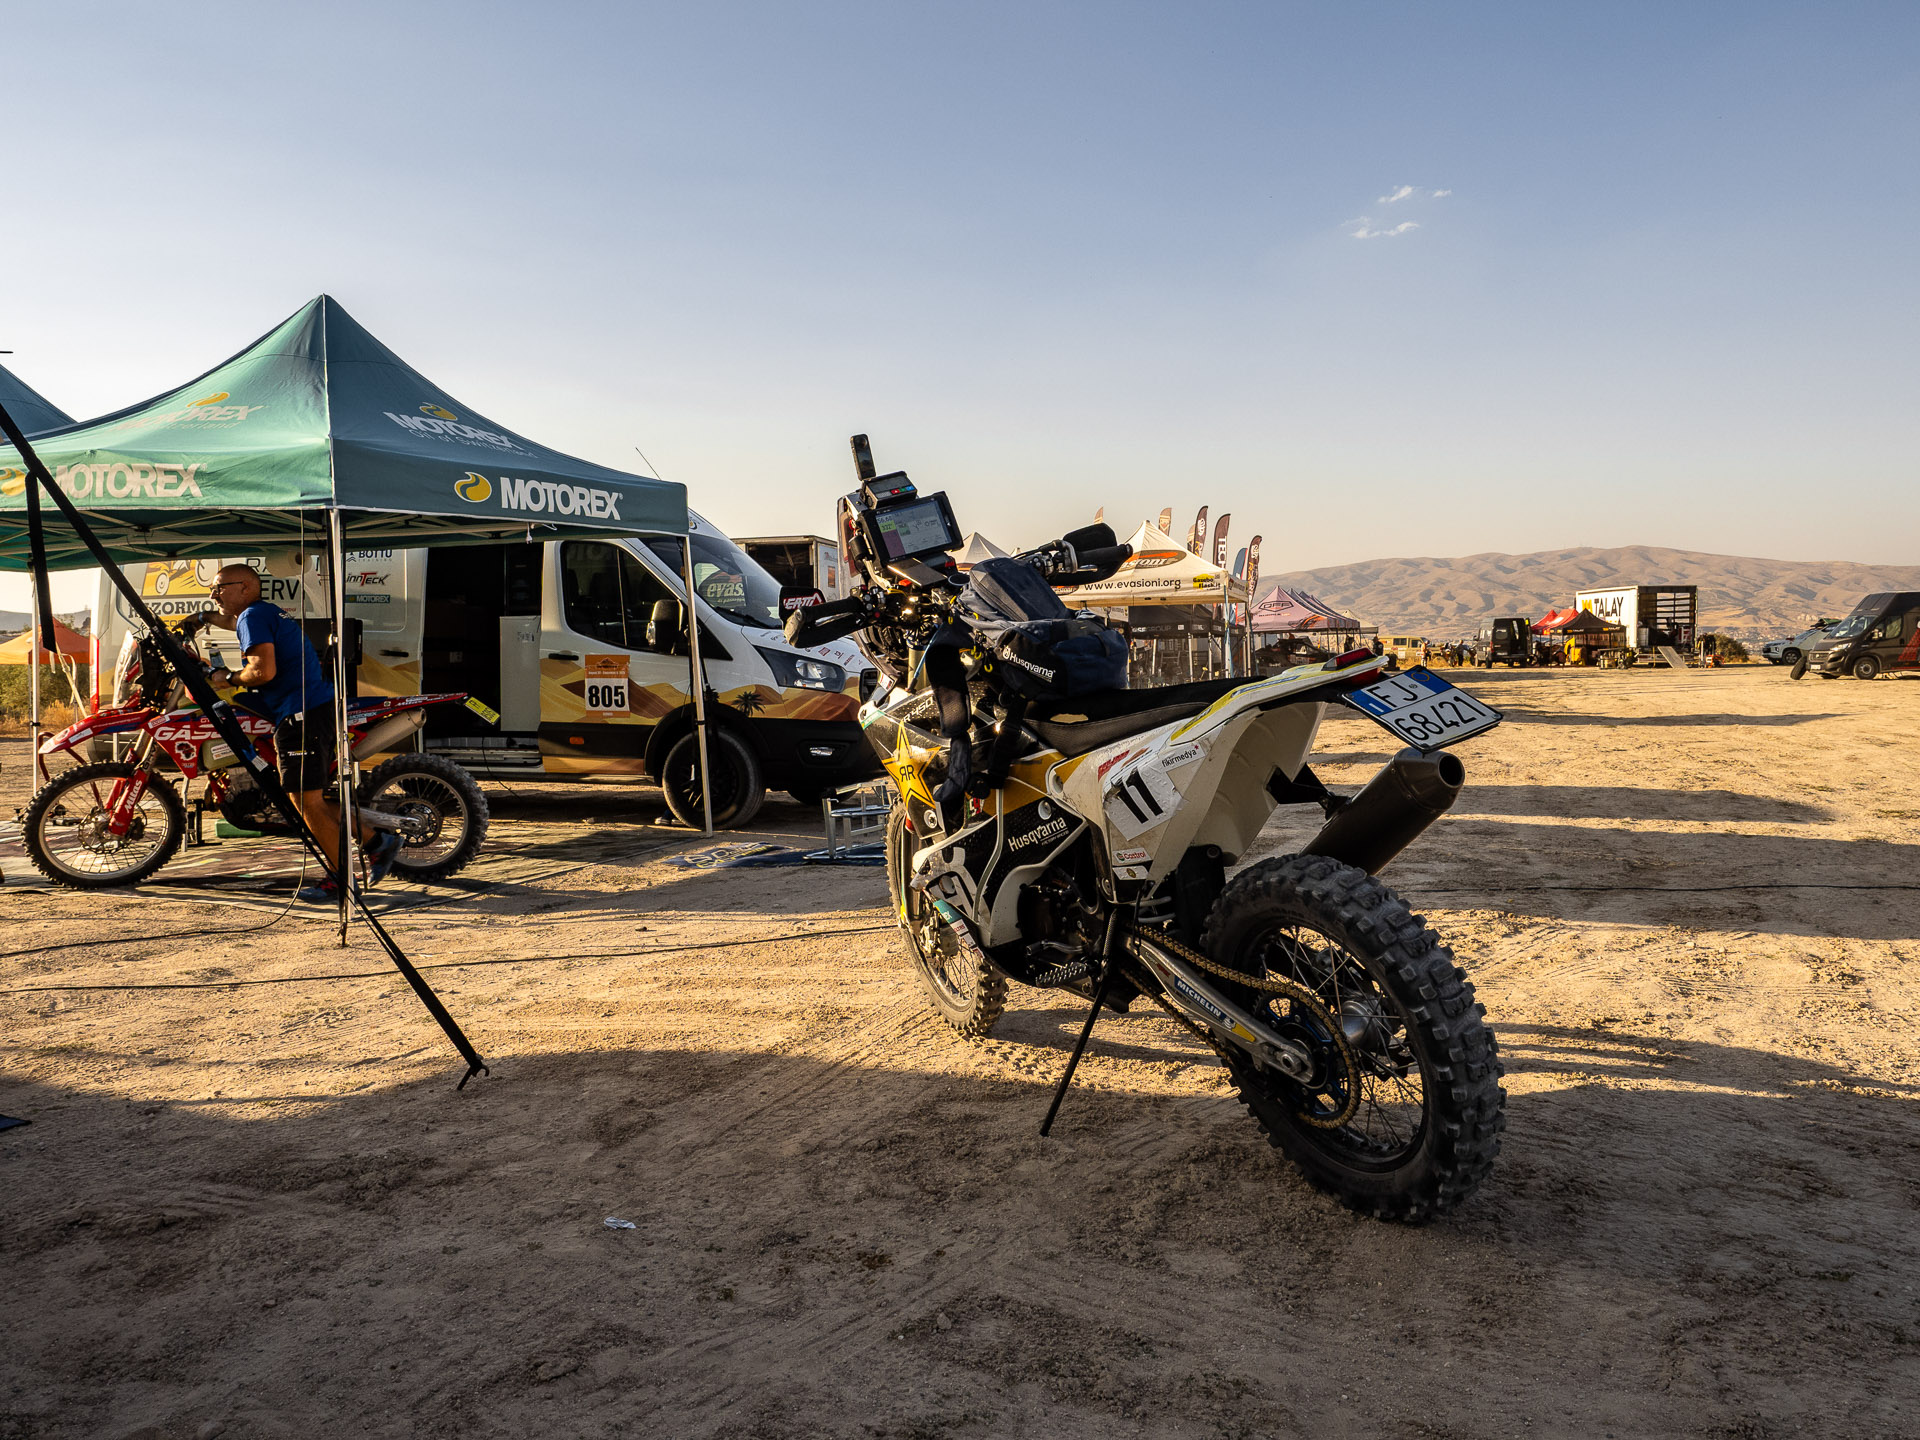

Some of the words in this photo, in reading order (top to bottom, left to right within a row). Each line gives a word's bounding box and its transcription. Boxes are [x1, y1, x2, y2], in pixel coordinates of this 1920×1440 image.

[382, 411, 526, 451] MOTOREX
[500, 476, 621, 521] MOTOREX
[706, 582, 745, 599] evas
[1084, 578, 1182, 591] www.evasioni.org
[356, 595, 390, 603] MOTOREX
[1594, 596, 1624, 617] TALAY
[1009, 651, 1054, 678] Husqvarna
[587, 684, 626, 708] 805
[1366, 680, 1419, 708] FJ
[153, 719, 275, 741] GASAS
[1394, 695, 1487, 741] 68421
[1161, 749, 1198, 768] fikirmedya
[1116, 766, 1164, 824] 11
[1007, 817, 1067, 852] Husqvarna
[1123, 850, 1147, 860] Castrol
[1177, 980, 1223, 1018] MICHELIN
